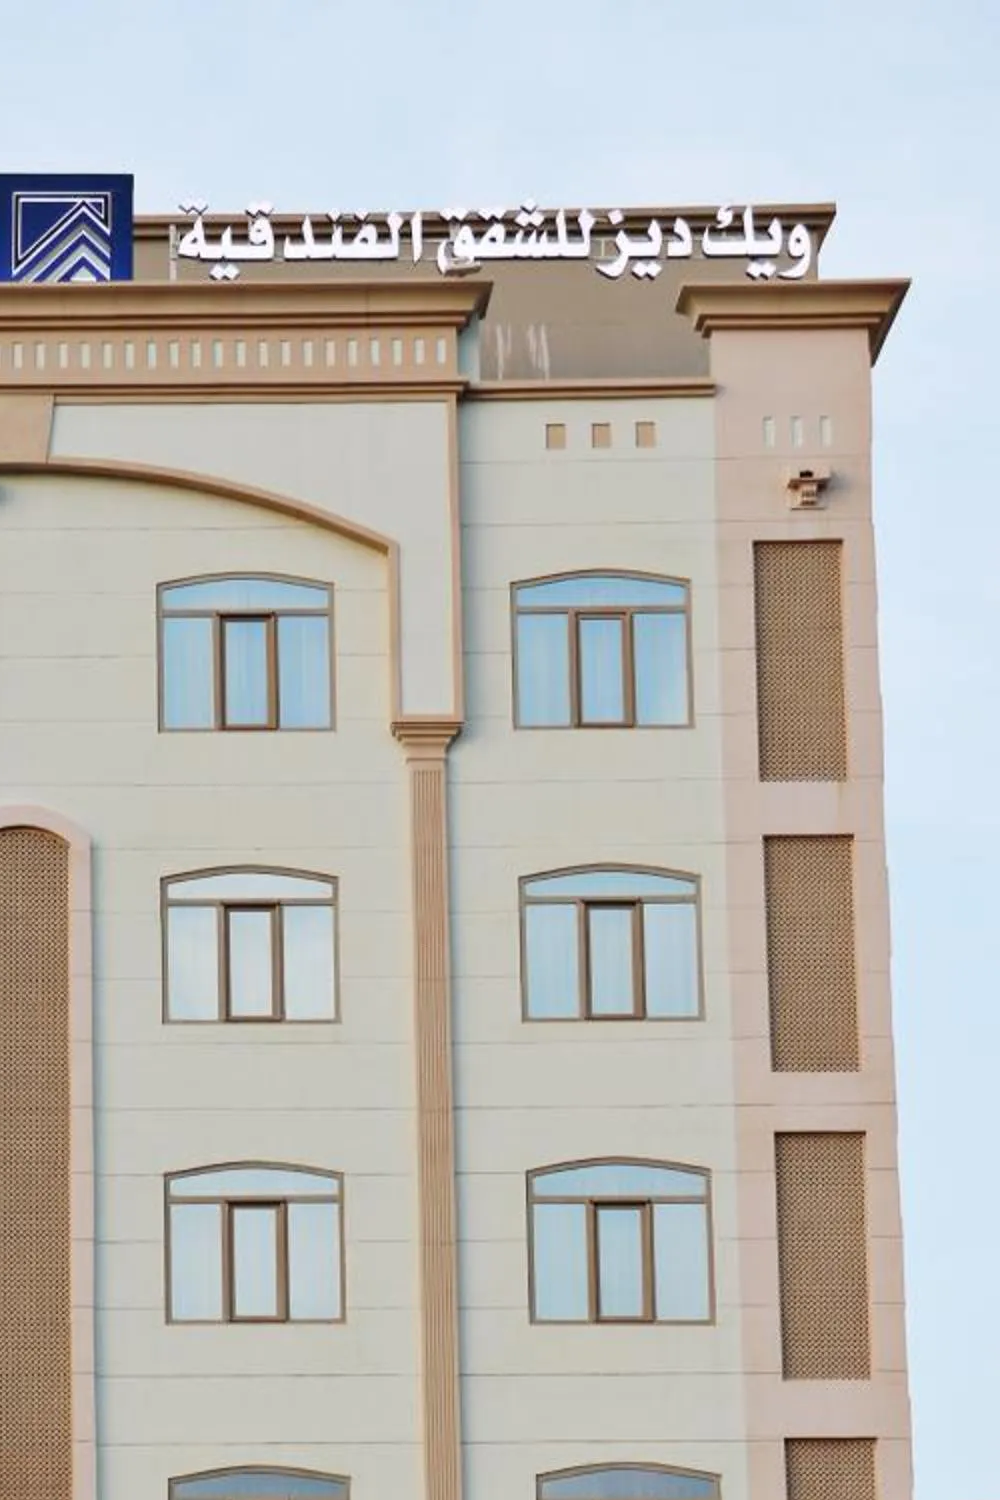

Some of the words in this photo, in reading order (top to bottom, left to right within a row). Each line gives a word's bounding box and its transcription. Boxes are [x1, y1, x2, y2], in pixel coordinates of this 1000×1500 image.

[177, 200, 424, 280] الفندقية
[437, 199, 595, 275] للشقق
[597, 208, 694, 279] ديز
[702, 203, 813, 279] ويك
